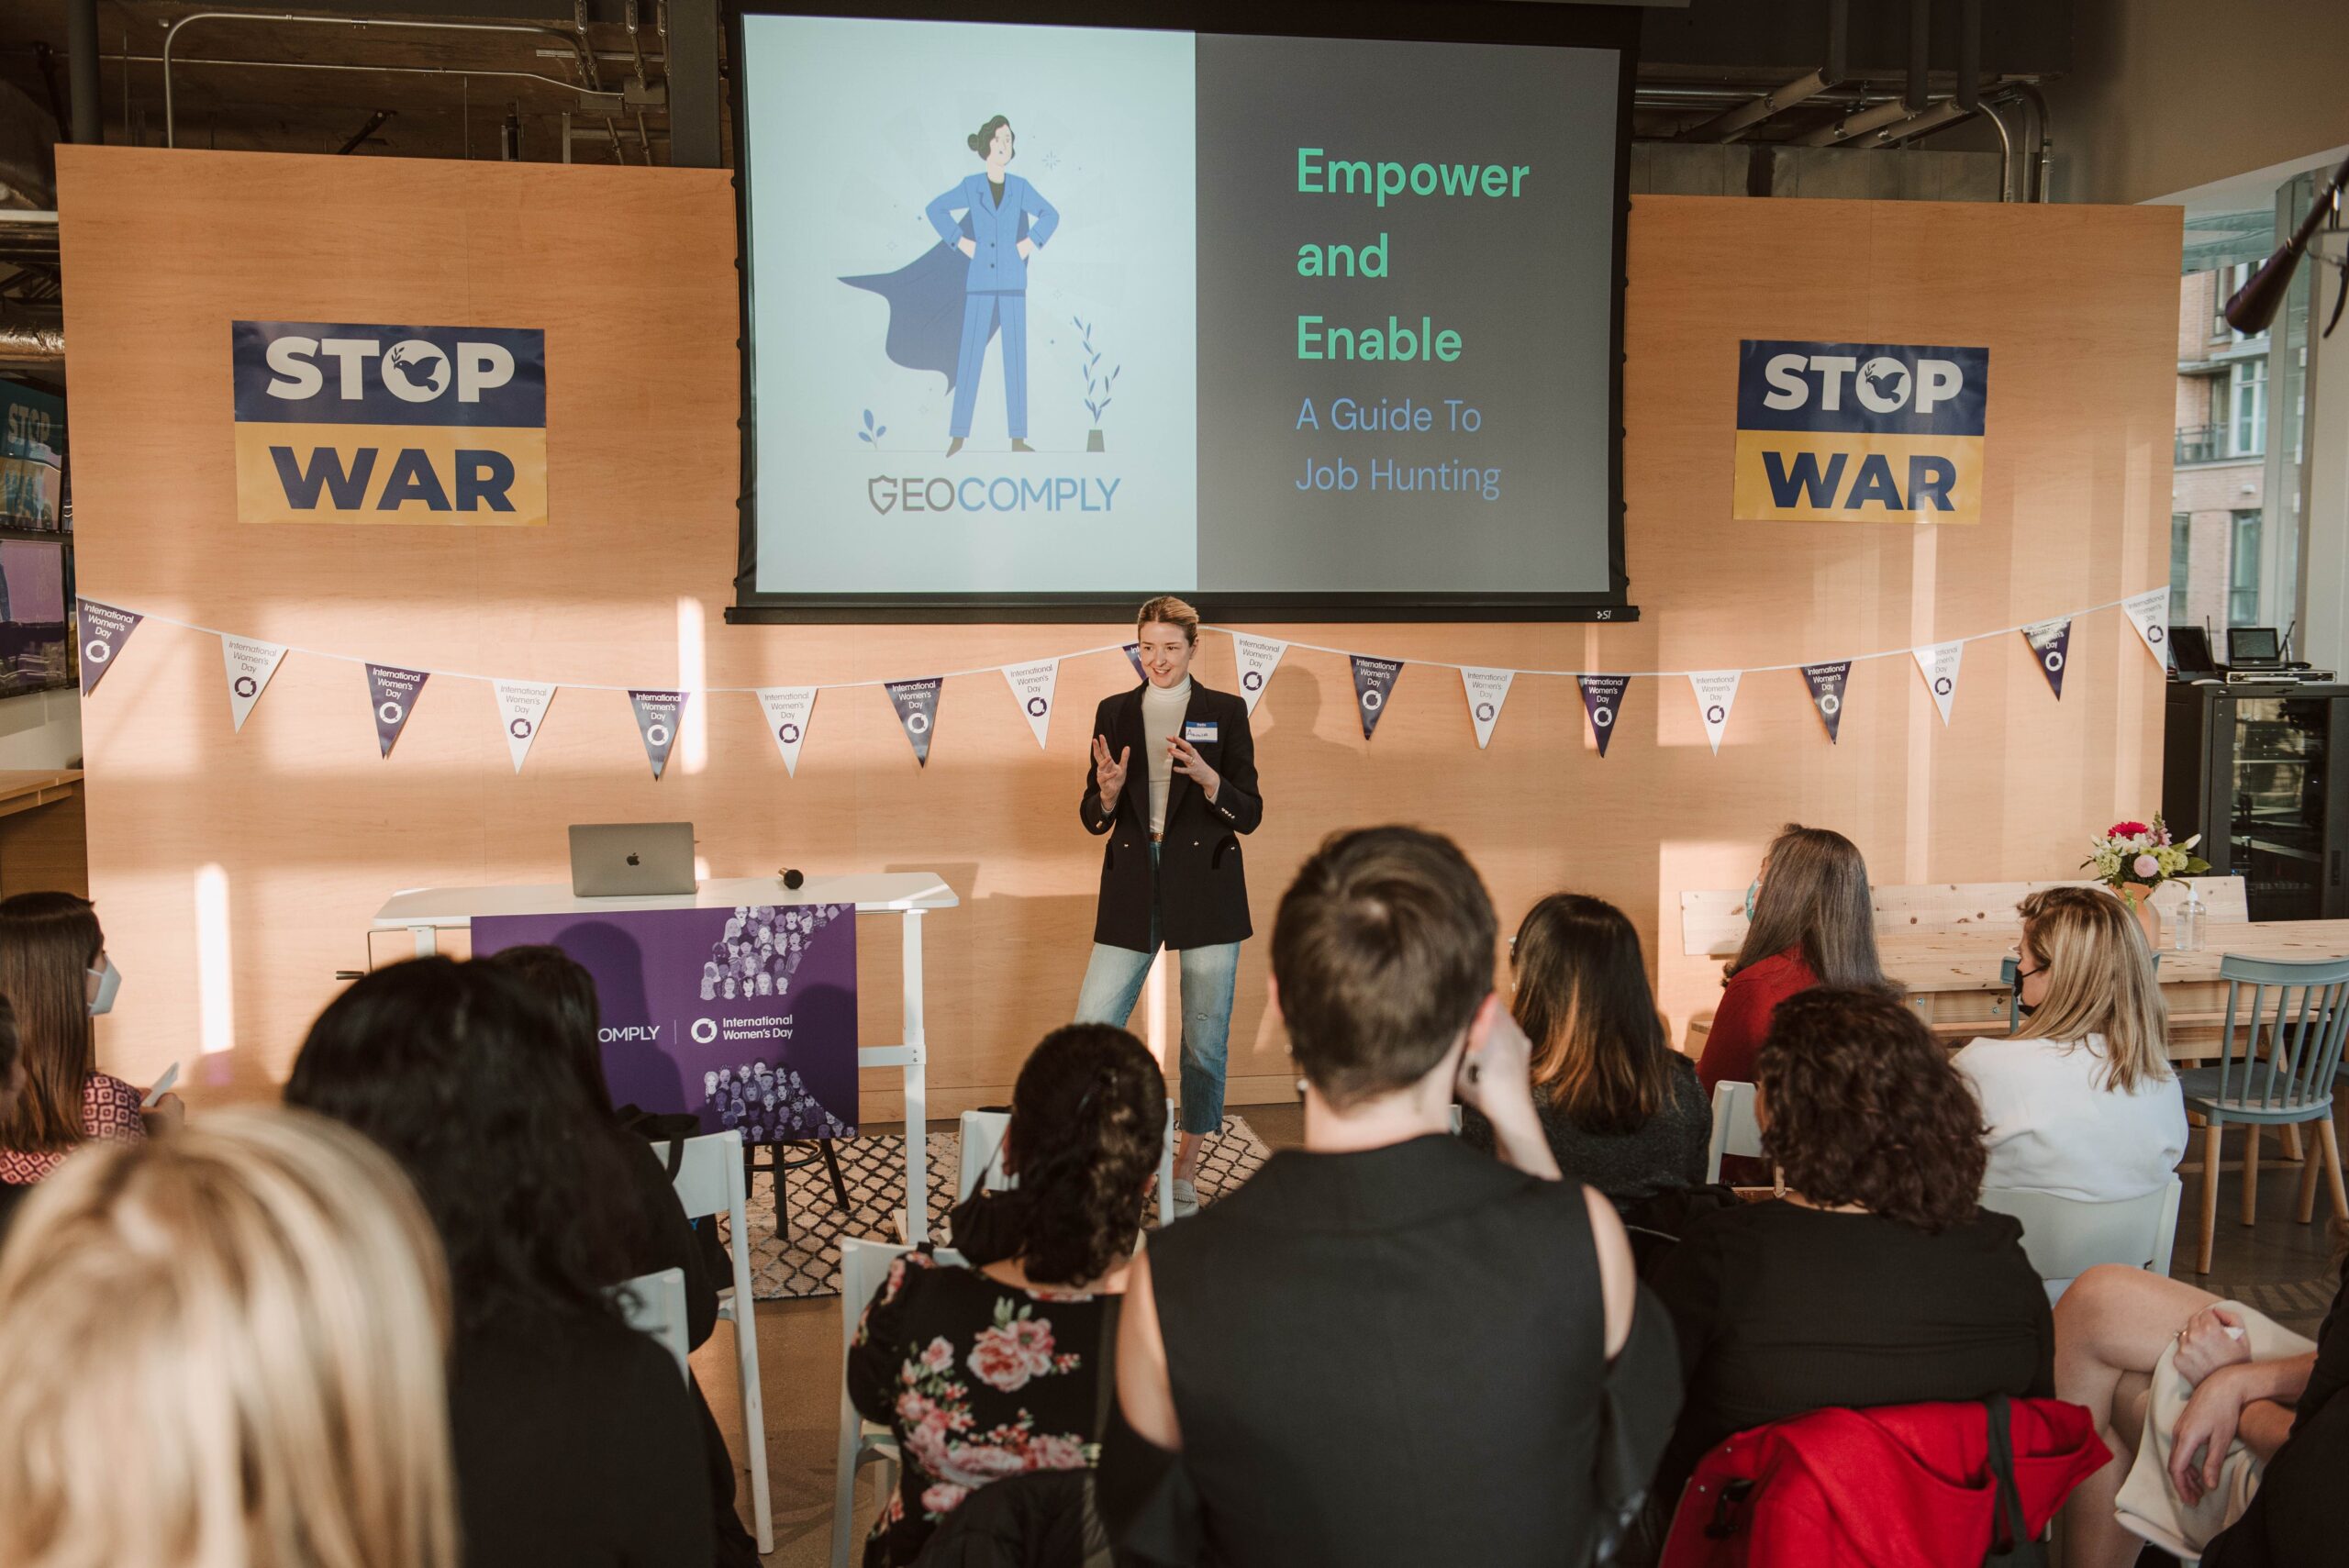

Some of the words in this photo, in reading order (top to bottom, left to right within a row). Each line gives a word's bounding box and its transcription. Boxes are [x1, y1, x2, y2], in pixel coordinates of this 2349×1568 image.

[1297, 148, 1531, 207] Empower
[1297, 232, 1388, 278] and
[1297, 316, 1463, 361] Enable
[266, 336, 515, 403] STOP
[1763, 353, 1964, 413] STOP
[1296, 397, 1319, 430] A
[1331, 397, 1432, 431] Guide
[1443, 399, 1482, 432] To
[269, 446, 516, 512] WAR
[1296, 458, 1359, 491] Job
[1372, 459, 1501, 501] Hunting
[1762, 451, 1956, 511] WAR
[868, 474, 1121, 516] GEOCOMPLY
[84, 603, 134, 624] International
[88, 615, 125, 632] Women's
[95, 626, 112, 639] Day
[228, 641, 277, 657] International
[1239, 639, 1280, 653] International
[233, 651, 269, 666] Women's
[1242, 649, 1273, 662] Women's
[241, 663, 257, 674] Day
[1249, 659, 1263, 669] Day
[1356, 659, 1397, 672] International
[1808, 664, 1845, 676] International
[1935, 666, 1947, 674] Day
[373, 668, 421, 683] International
[1010, 664, 1053, 678] International
[1360, 668, 1390, 680] Women's
[1017, 674, 1049, 686] Women's
[1367, 678, 1381, 688] Day
[1467, 673, 1507, 682] International
[1584, 677, 1623, 686] International
[1696, 674, 1735, 684] International
[1812, 673, 1842, 684] Women's
[377, 678, 413, 691] Women's
[501, 685, 547, 696] International
[892, 681, 936, 693] International
[1472, 682, 1502, 690] Women's
[1588, 686, 1618, 695] Women's
[1701, 684, 1731, 693] Women's
[1821, 683, 1834, 691] Day
[386, 689, 402, 700] Day
[506, 695, 540, 706] Women's
[636, 694, 682, 702] International
[764, 692, 809, 701] International
[898, 690, 931, 701] Women's
[1479, 691, 1493, 699] Day
[1597, 695, 1609, 704] Day
[1709, 694, 1722, 702] Day
[515, 706, 529, 715] Day
[641, 703, 676, 711] Women's
[771, 701, 804, 710] Women's
[908, 701, 923, 709] Day
[651, 712, 666, 722] Day
[781, 711, 795, 719] Day
[723, 1015, 793, 1028] International
[597, 1026, 661, 1042] OMPLY
[723, 1028, 771, 1040] Women's
[773, 1027, 794, 1040] Day
